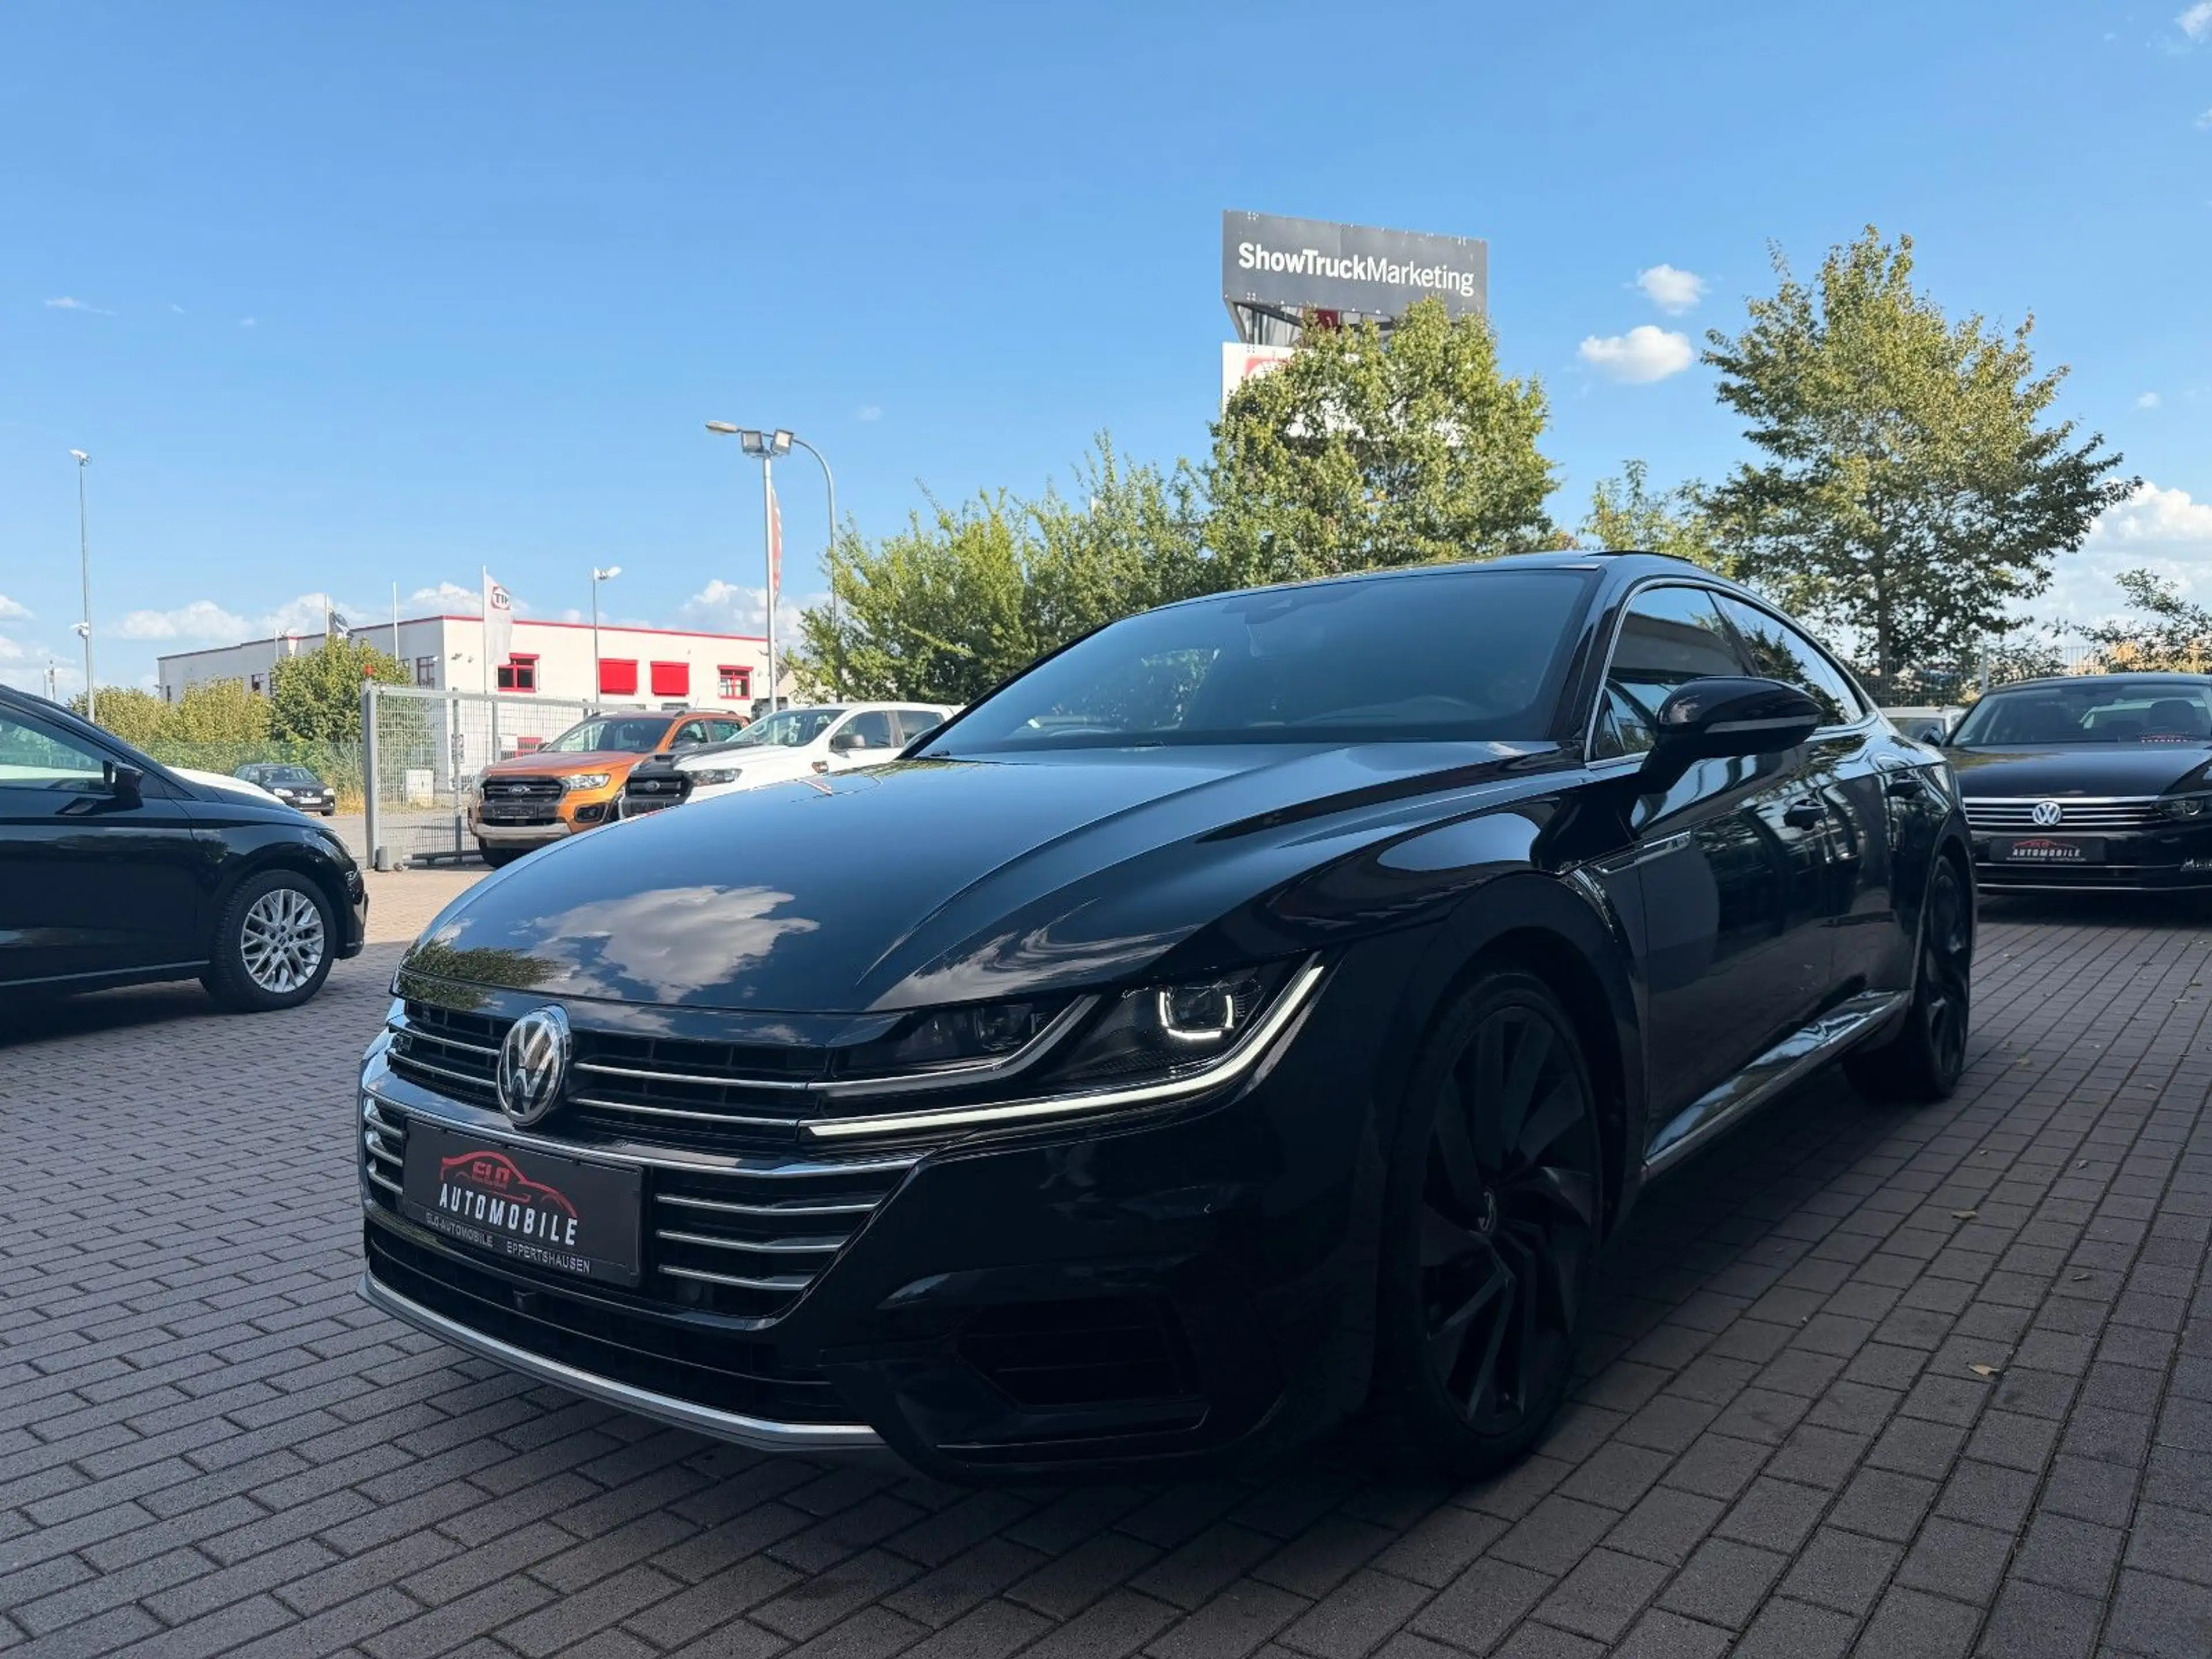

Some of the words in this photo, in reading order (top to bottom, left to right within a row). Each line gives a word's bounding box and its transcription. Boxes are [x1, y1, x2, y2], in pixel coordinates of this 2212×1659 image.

[1238, 242, 1474, 297] ShowTruckMarketing
[2013, 849, 2080, 857] AUTOMOBILE
[440, 1183, 578, 1245] AUTOMOBILE
[507, 1241, 590, 1275] EPPERTSHAUSEN
